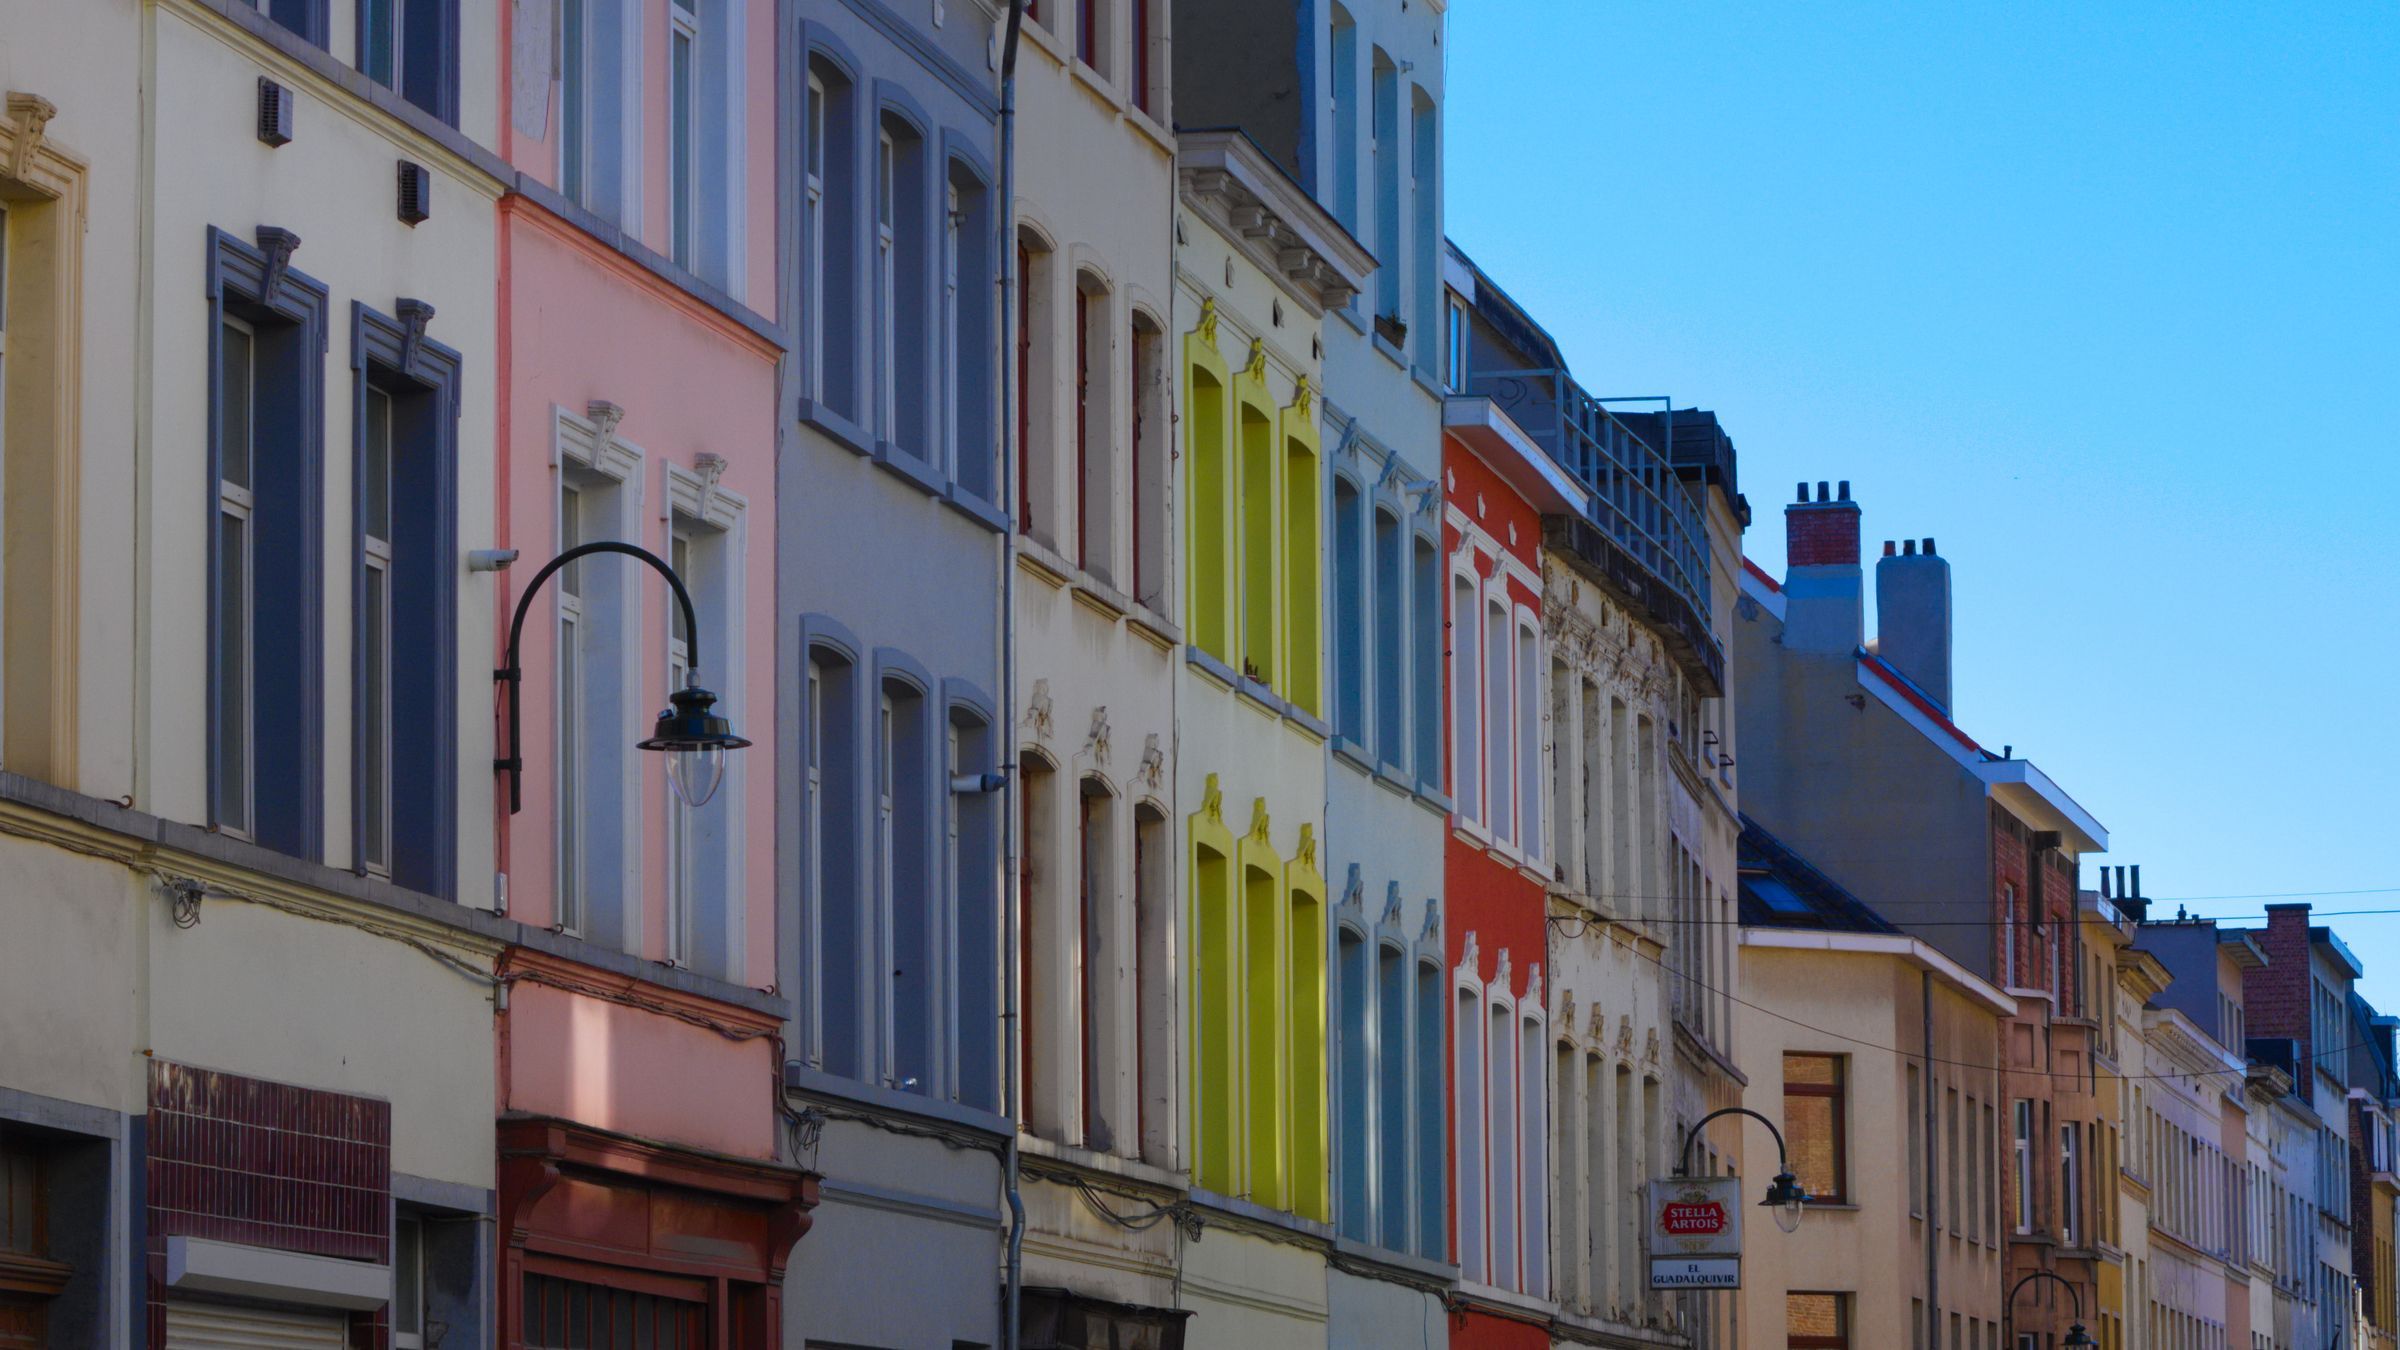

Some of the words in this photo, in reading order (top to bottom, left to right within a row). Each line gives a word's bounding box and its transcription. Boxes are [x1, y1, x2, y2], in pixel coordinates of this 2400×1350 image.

[1671, 1208, 1717, 1217] STELLA
[1670, 1219, 1718, 1229] ARTOIS
[1688, 1264, 1700, 1272] EL
[1653, 1275, 1735, 1284] GUADALQUIVIR
